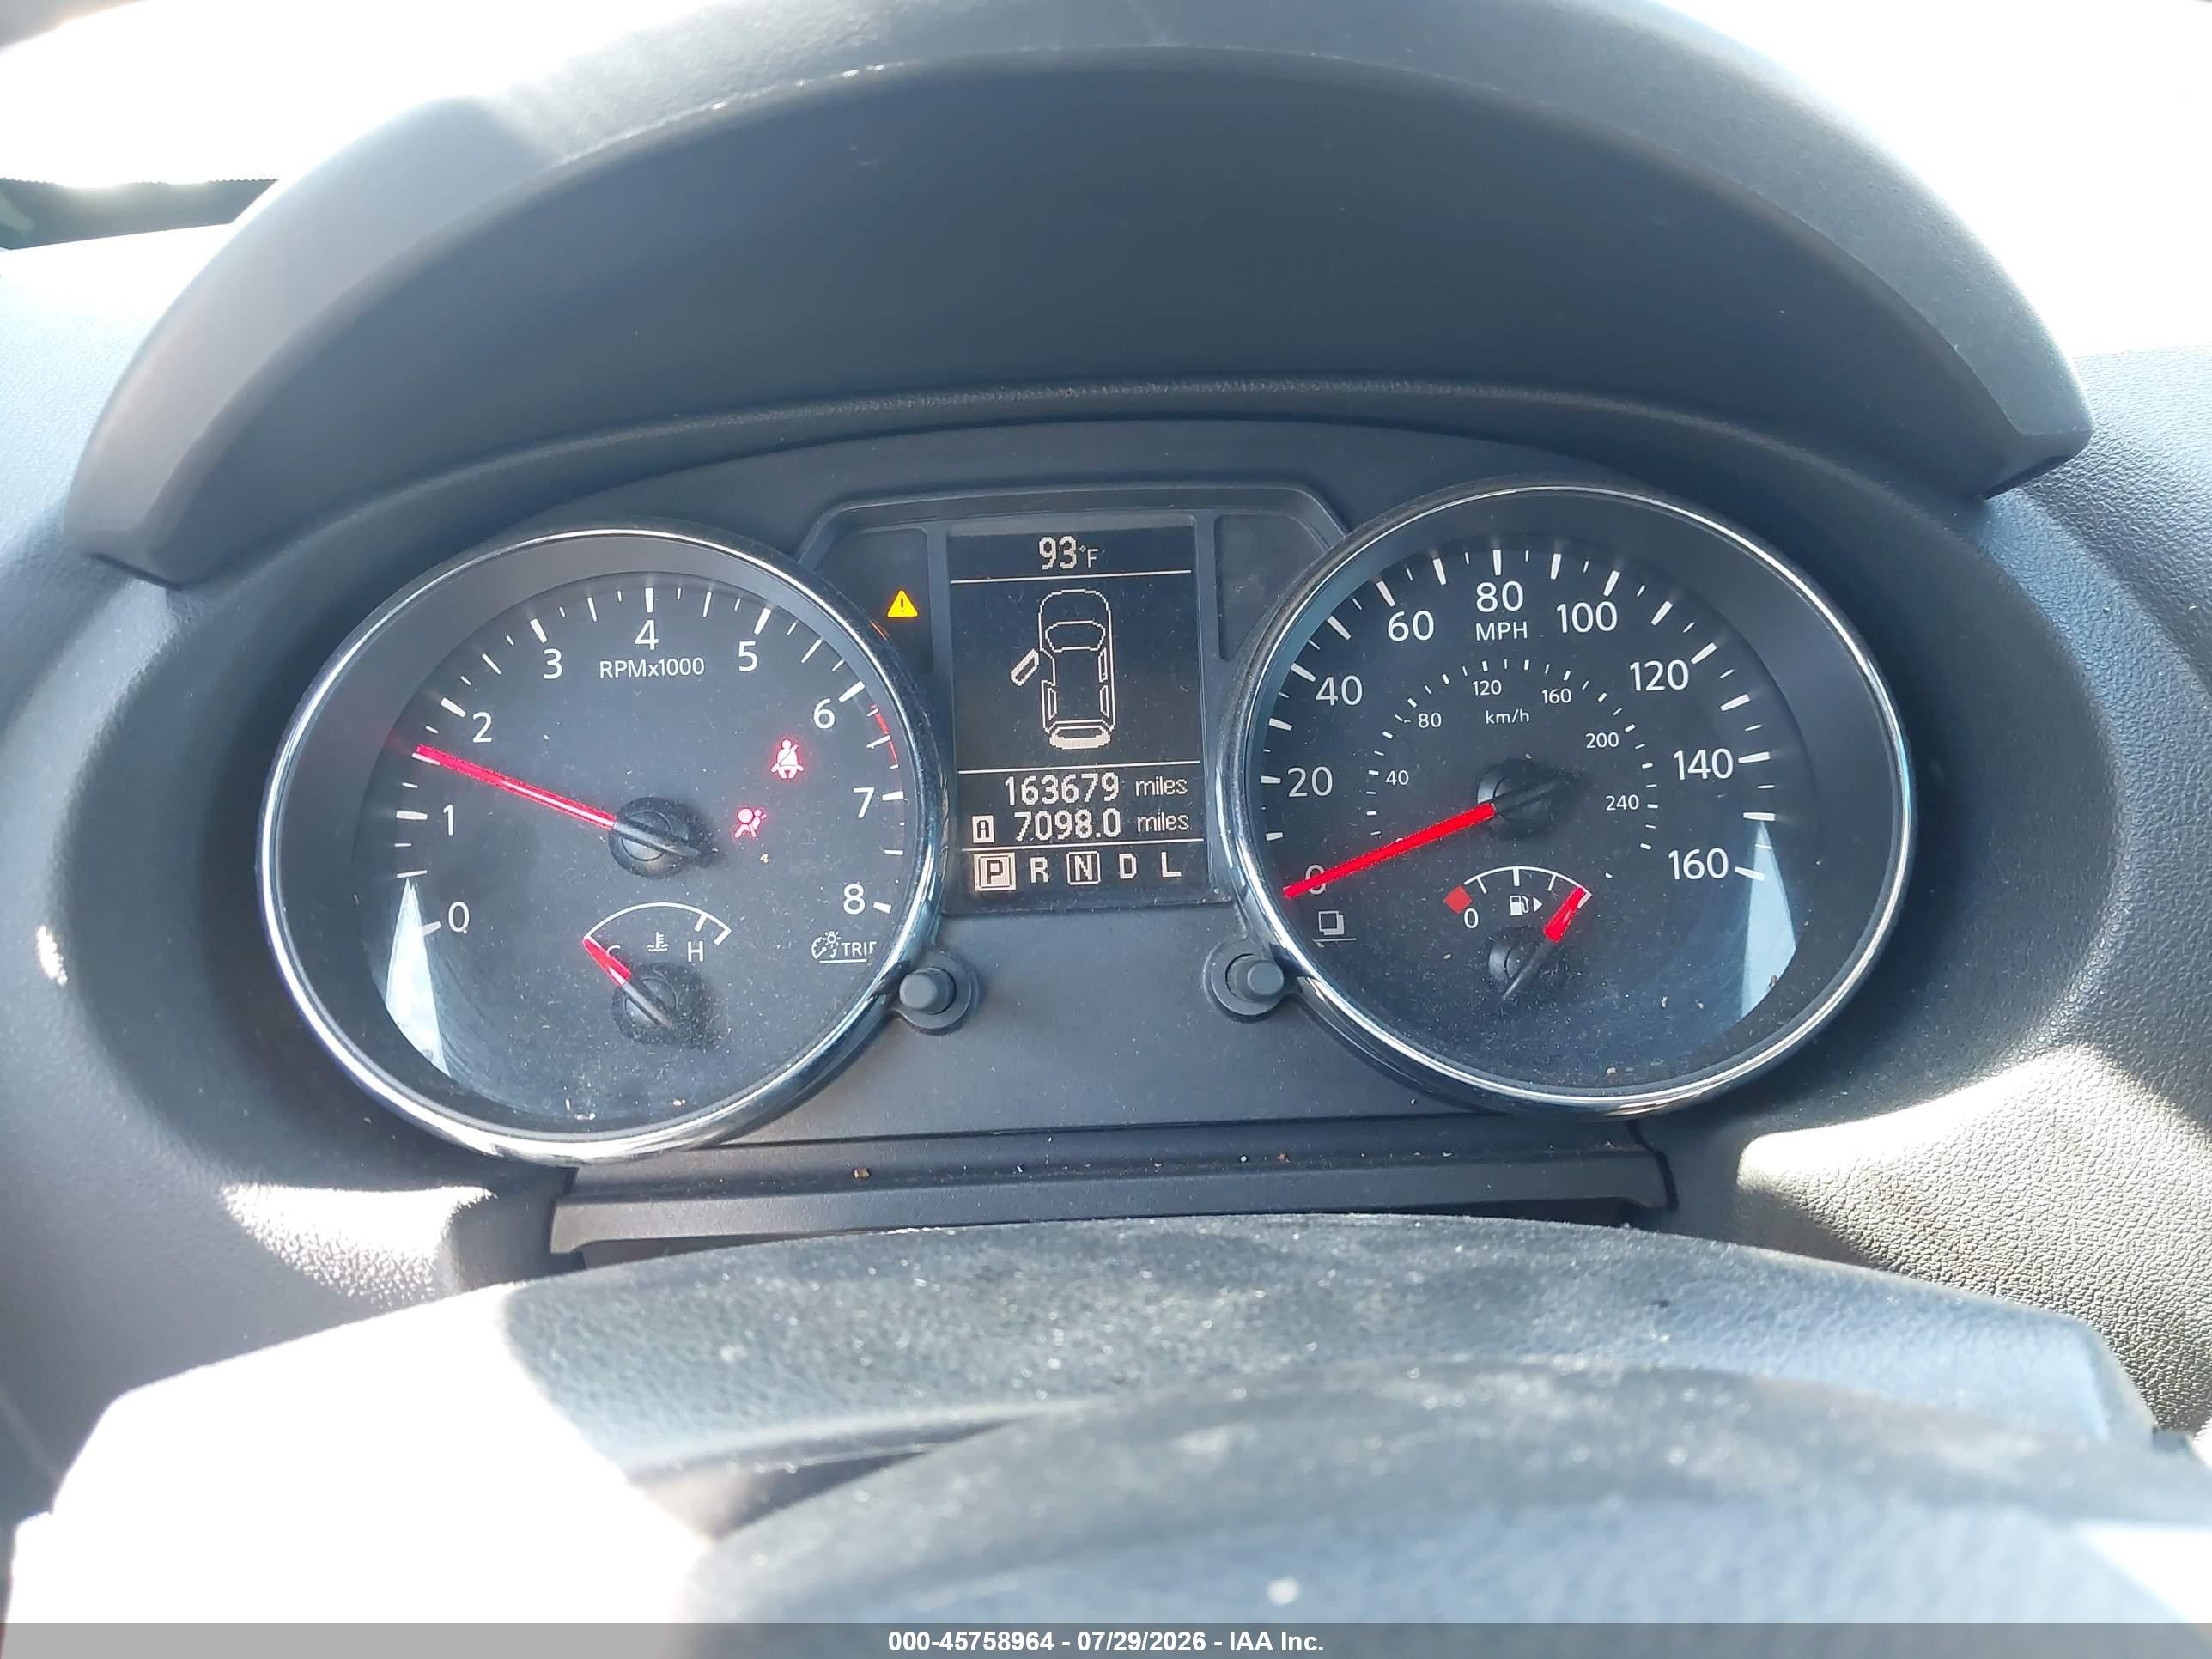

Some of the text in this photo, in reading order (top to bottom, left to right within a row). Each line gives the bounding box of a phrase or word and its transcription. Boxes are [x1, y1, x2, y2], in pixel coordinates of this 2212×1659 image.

[1476, 580, 1523, 612] 80
[1388, 610, 1434, 641] 60
[1475, 621, 1528, 641] MPH
[1556, 601, 1618, 633] 100
[635, 619, 659, 651] 4
[544, 648, 562, 679] 3
[599, 657, 705, 678] RPMx1000
[738, 641, 758, 672] 5
[1472, 679, 1502, 696] 120
[1630, 659, 1689, 691] 120
[1316, 676, 1363, 706] 40
[1541, 688, 1572, 704] 160
[472, 711, 492, 743] 2
[813, 698, 836, 729] 6
[1418, 712, 1442, 728] 80
[1486, 708, 1529, 725] km/h
[1585, 732, 1620, 749] 200
[1385, 769, 1409, 786] 40
[1674, 748, 1734, 781] 140
[1005, 772, 1188, 805] 163679 miles
[1287, 766, 1333, 798] 20
[853, 787, 875, 818] 7
[1605, 794, 1639, 811] 240
[443, 804, 453, 836] 1
[1014, 807, 1121, 840] 7098.0
[1137, 811, 1189, 832] miles
[985, 851, 1182, 884] P R N D L
[1668, 848, 1729, 880] 160
[843, 883, 866, 915] 8
[448, 901, 470, 934] 0
[1464, 908, 1479, 929] 0
[687, 940, 704, 963] H
